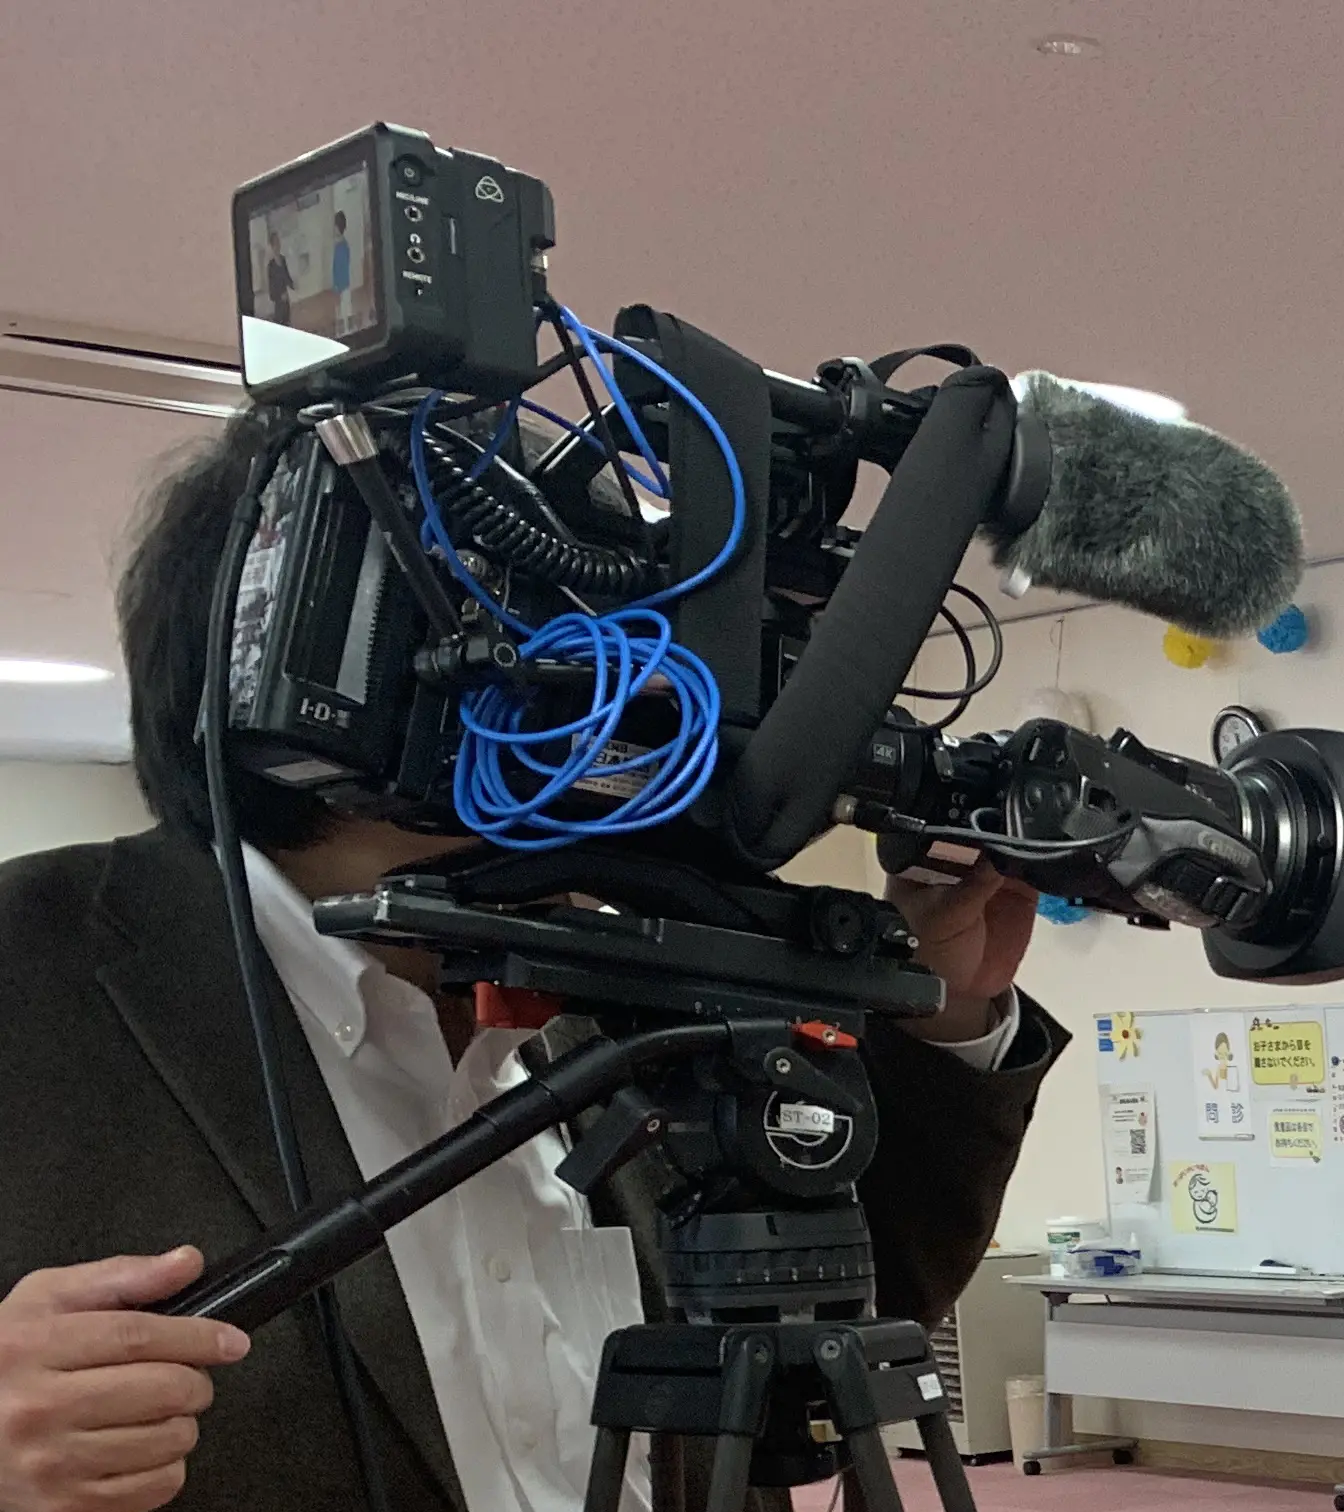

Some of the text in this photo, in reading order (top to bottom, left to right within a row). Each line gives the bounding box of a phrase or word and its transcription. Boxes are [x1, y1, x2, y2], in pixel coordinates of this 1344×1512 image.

[875, 743, 894, 759] 4K
[1198, 831, 1251, 867] Canon
[781, 1109, 832, 1126] ST-02
